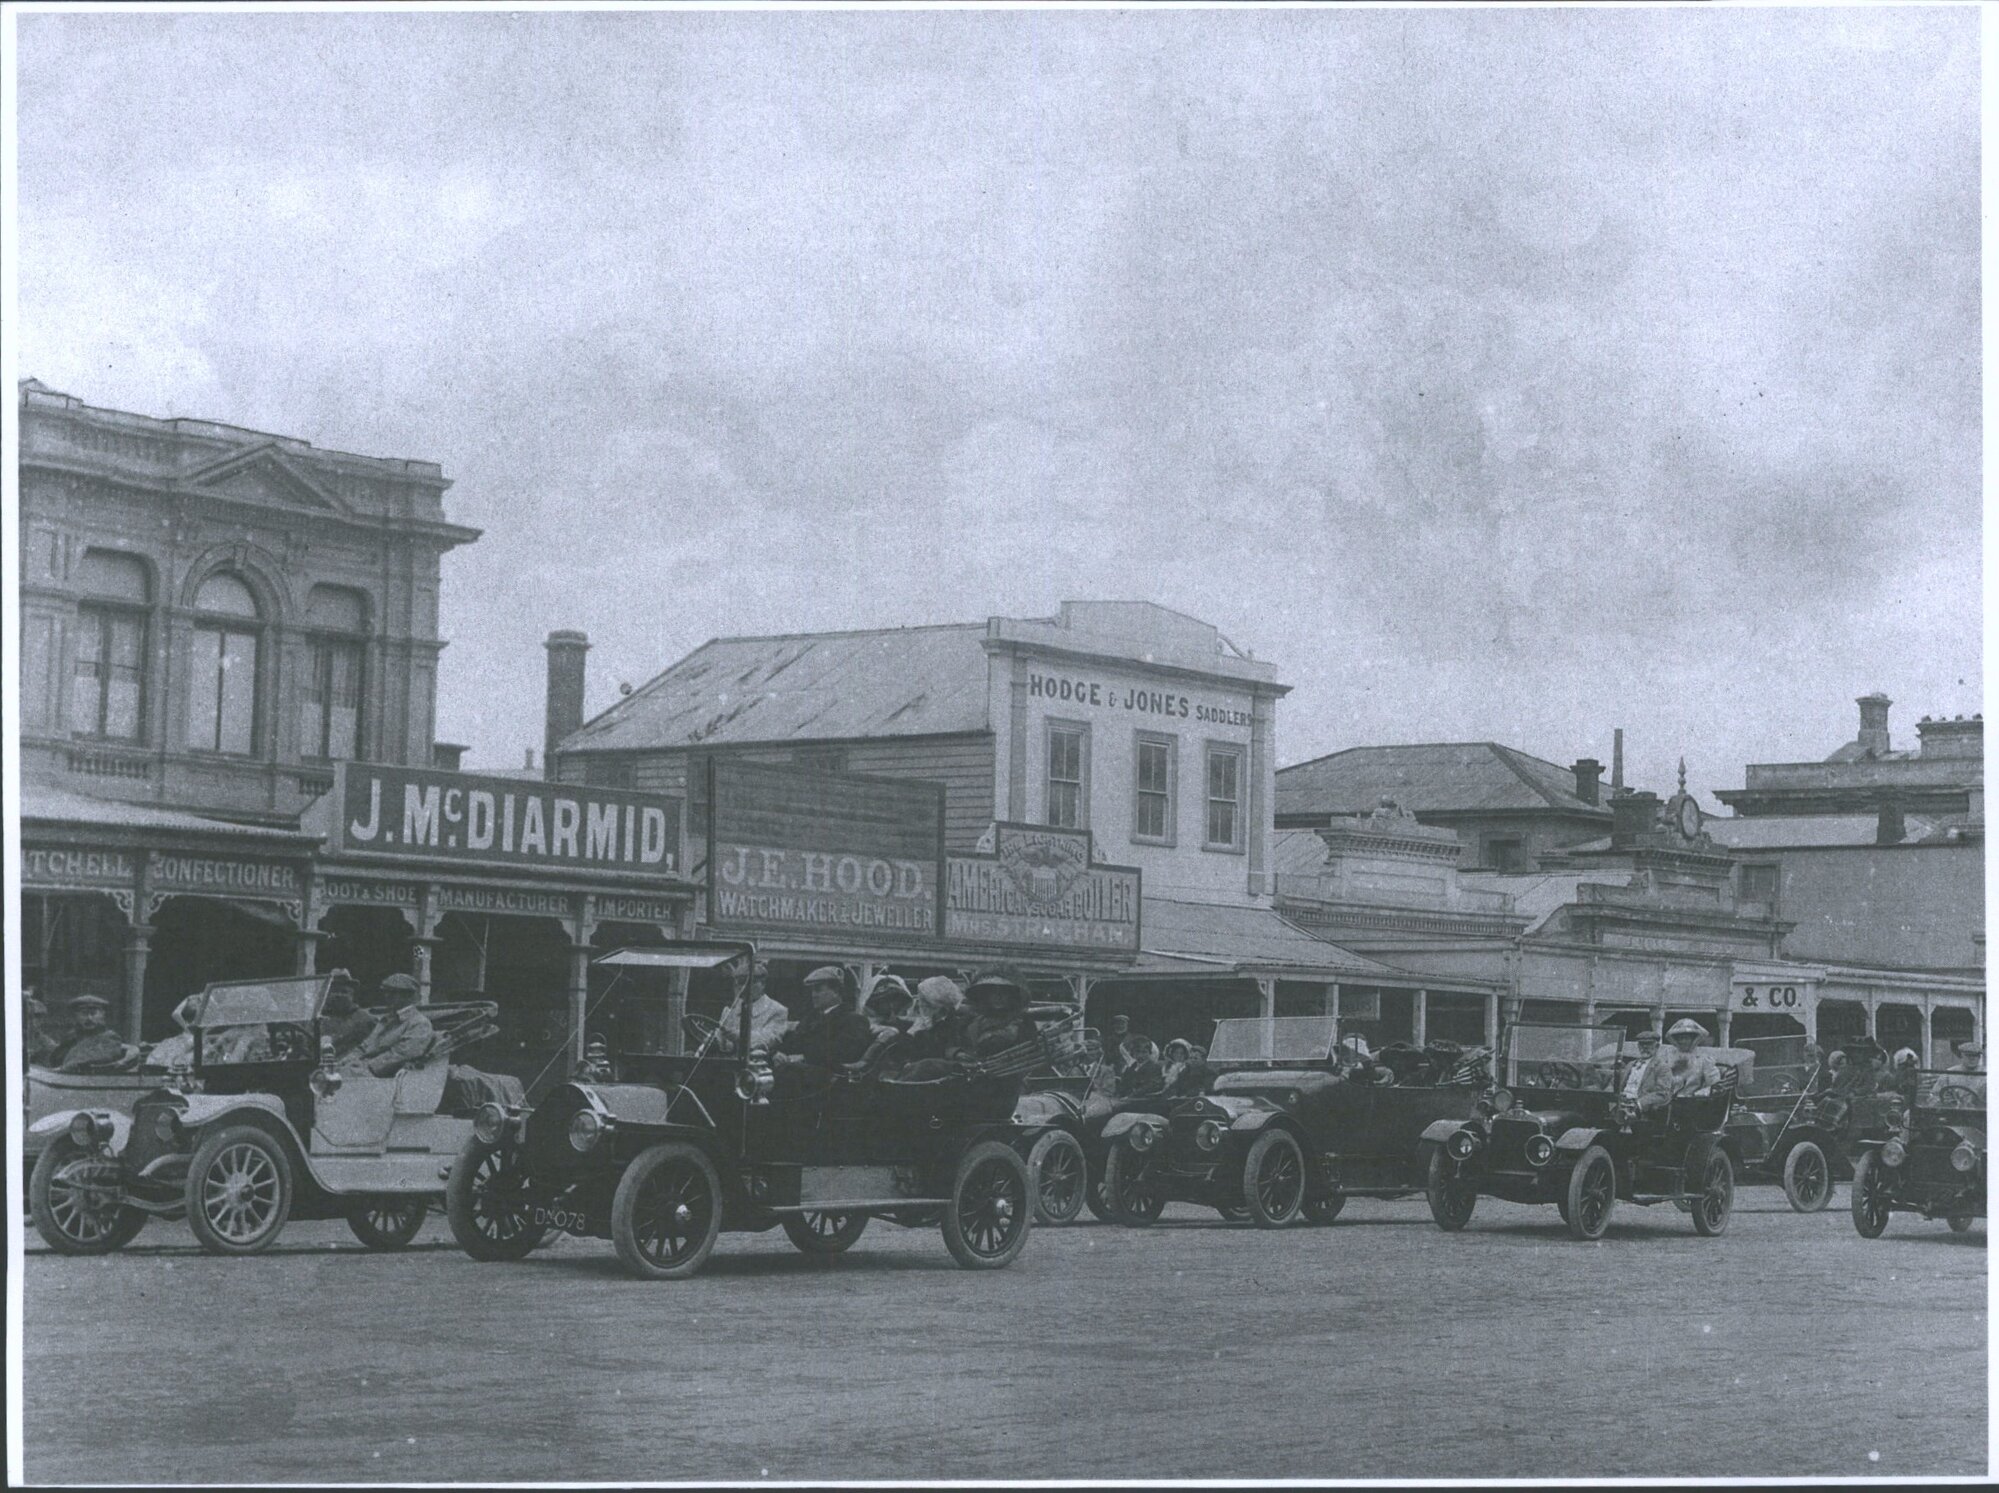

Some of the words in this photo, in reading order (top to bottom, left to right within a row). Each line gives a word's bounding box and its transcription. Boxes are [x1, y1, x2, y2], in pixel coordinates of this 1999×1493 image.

[1030, 674, 1101, 706] HODGE
[1108, 691, 1118, 708] &
[1124, 689, 1189, 718] JONES
[1196, 704, 1252, 727] SADDLERS
[350, 778, 393, 842] J.
[801, 853, 932, 899] HOOD.
[374, 885, 417, 903] SHOE
[440, 888, 569, 914] MANUFACTURER
[718, 890, 840, 923] WATCHMAKER
[850, 902, 933, 930] JEWELLER
[1742, 987, 1758, 1007] &
[1769, 986, 1802, 1008] CO.
